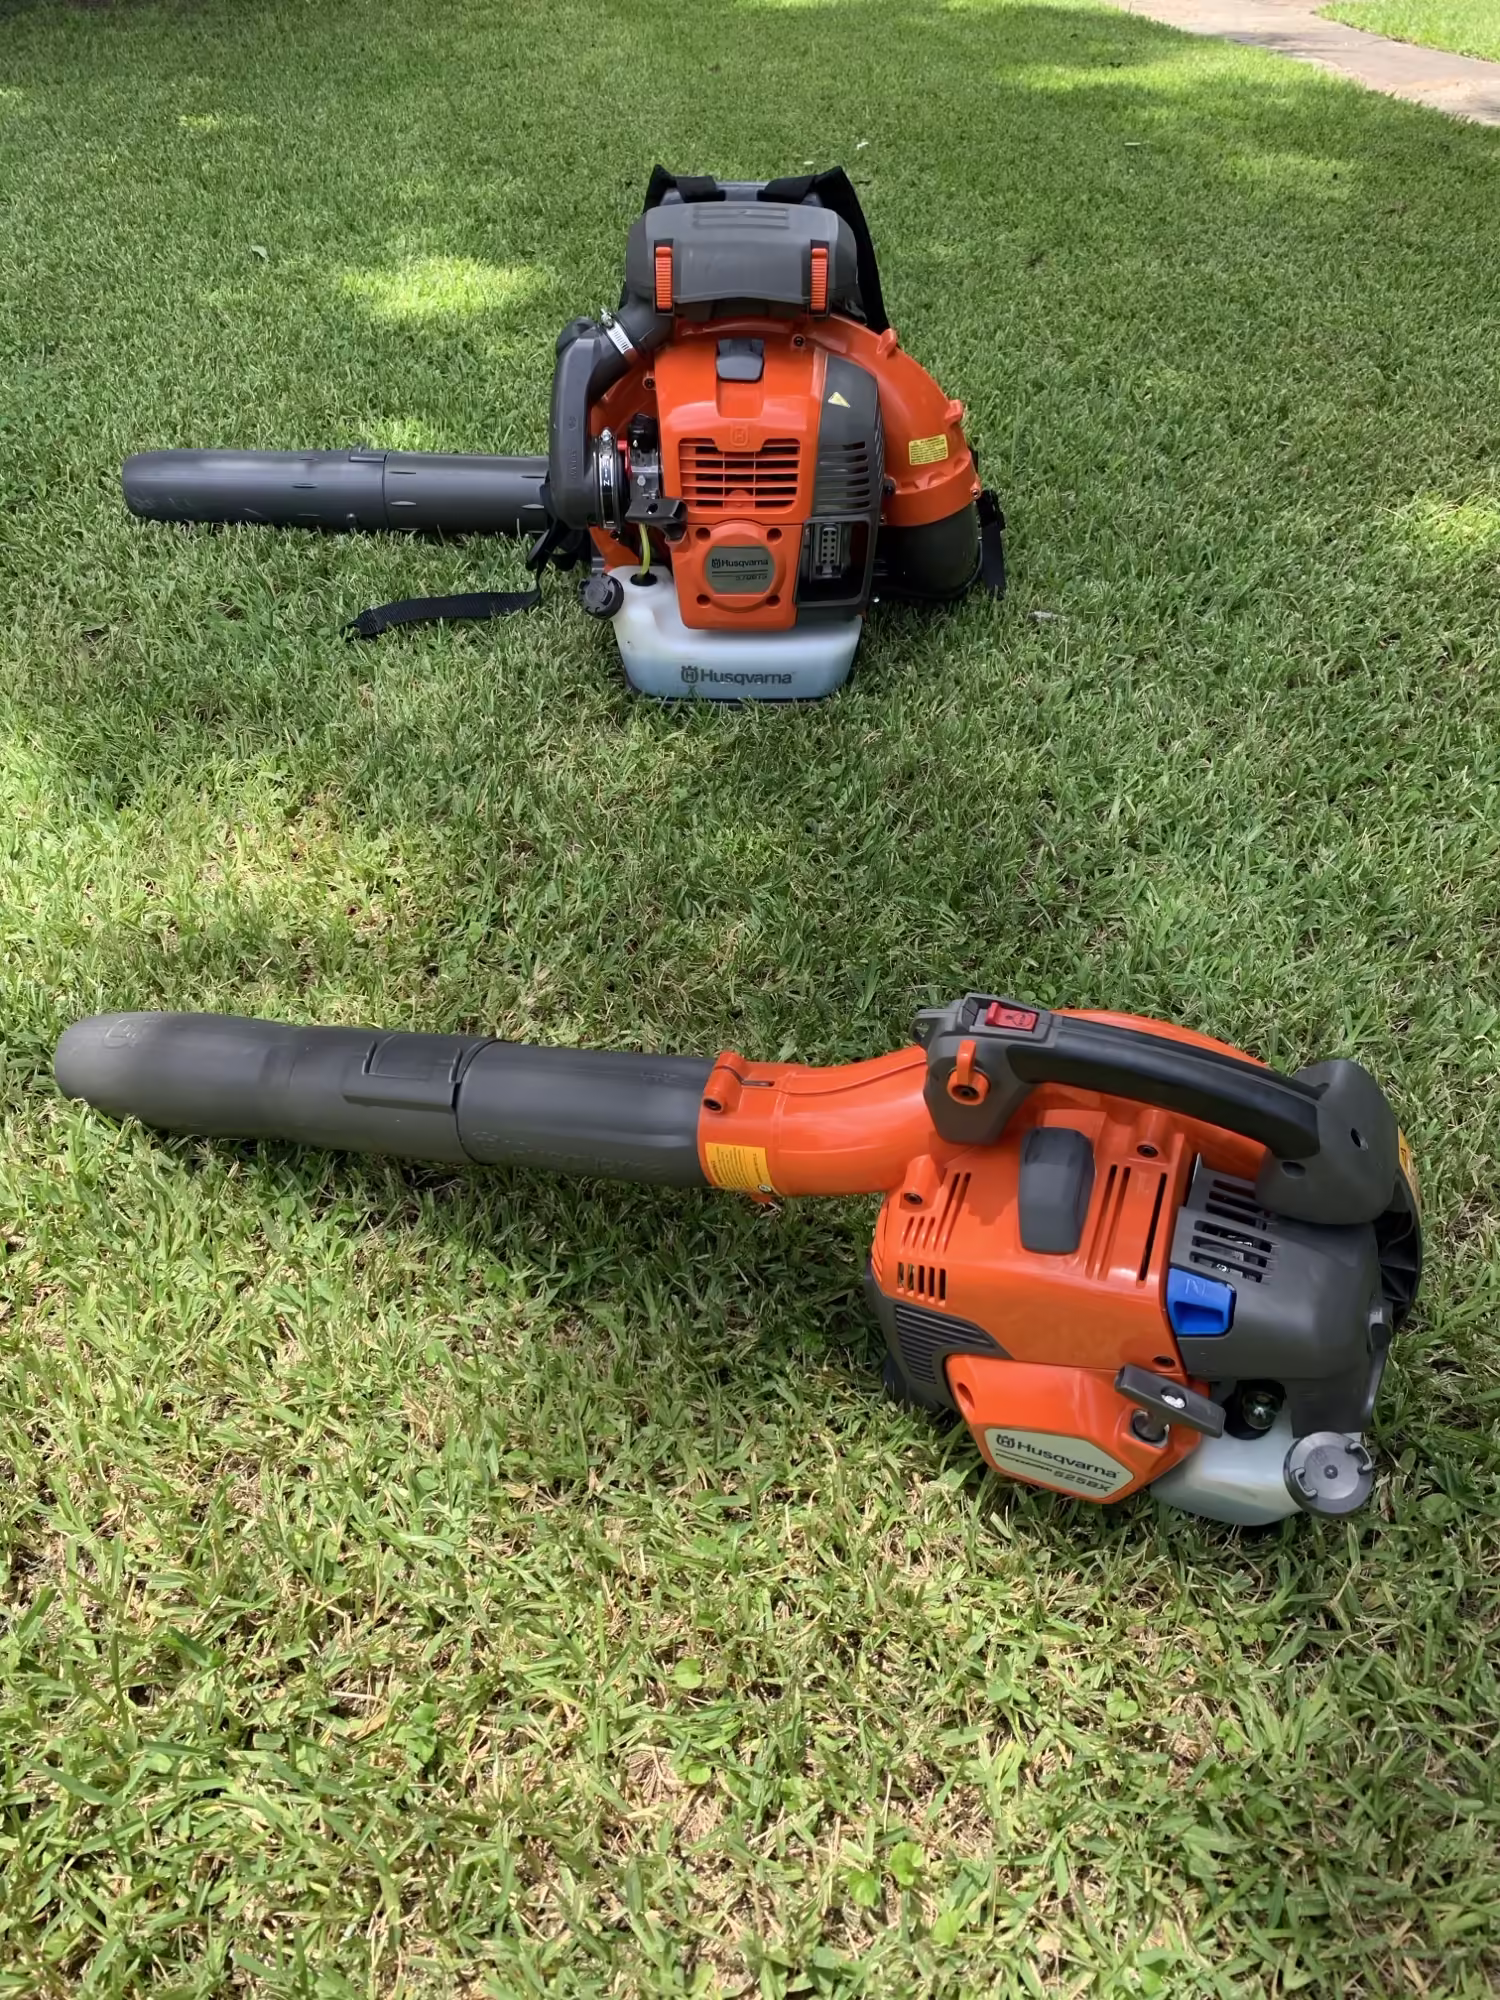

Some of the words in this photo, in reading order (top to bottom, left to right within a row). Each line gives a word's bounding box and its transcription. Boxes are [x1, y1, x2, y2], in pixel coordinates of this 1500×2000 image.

[721, 559, 769, 568] Husqvarna
[700, 669, 793, 685] Husqvarna
[1017, 1441, 1118, 1479] Husqvarna
